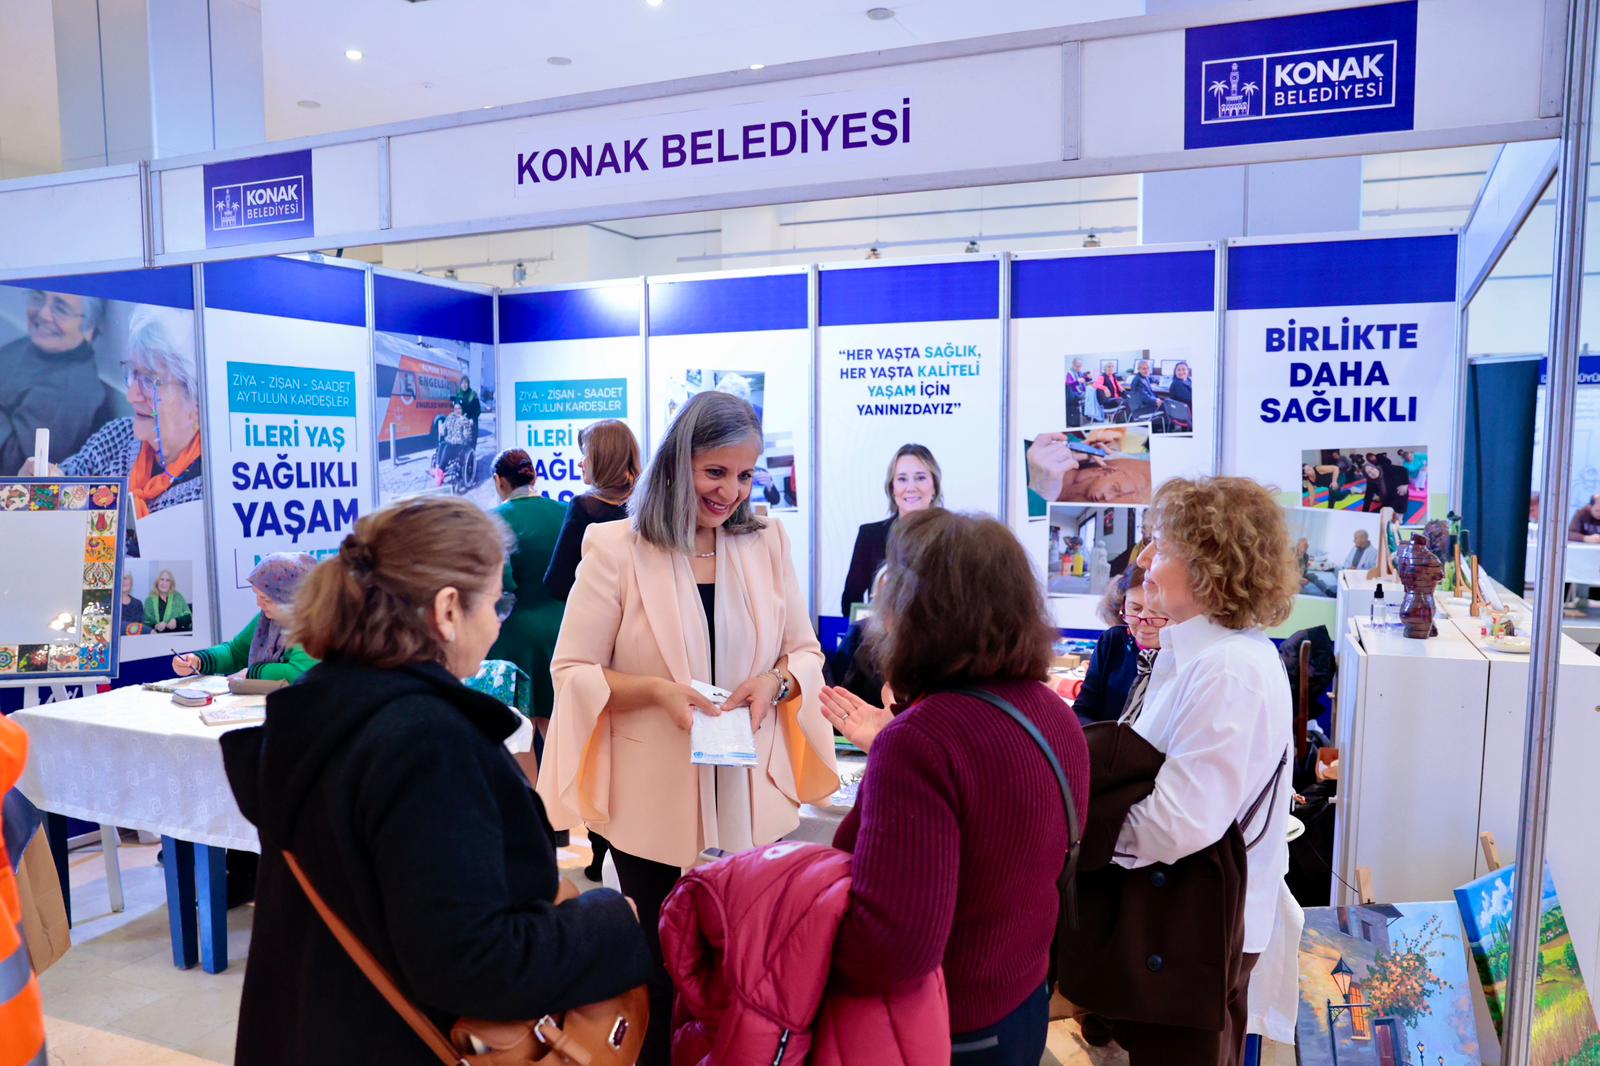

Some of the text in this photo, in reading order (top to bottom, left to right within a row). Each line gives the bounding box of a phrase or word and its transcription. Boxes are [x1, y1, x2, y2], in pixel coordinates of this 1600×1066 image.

[1275, 54, 1384, 87] KONAK
[1274, 77, 1383, 106] BELEDİYESİ
[517, 97, 910, 185] KONAK BELEDİYESİ
[246, 184, 298, 206] KONAK
[247, 200, 299, 219] BELEDİYESİ
[1265, 316, 1419, 353] BİRLİKTE
[877, 347, 920, 362] YAŞTA
[924, 342, 982, 359] SAĞLIK,
[840, 361, 980, 381] HER YAŞTA KALİTELİ
[1290, 360, 1390, 387] DAHA
[311, 379, 351, 393] SAADET
[584, 387, 624, 399] SAADET
[867, 381, 950, 399] YAŞAM İÇİN
[236, 391, 350, 408] AYTULUN KARDEŞLER
[521, 402, 564, 413] AYTULUN
[1260, 390, 1417, 423] SAĞLIKLI
[245, 417, 346, 453] İLERİ YAŞ
[527, 423, 573, 447] İLERİ
[232, 453, 358, 491] SAĞLIKLI
[232, 498, 358, 544] YAŞAM
